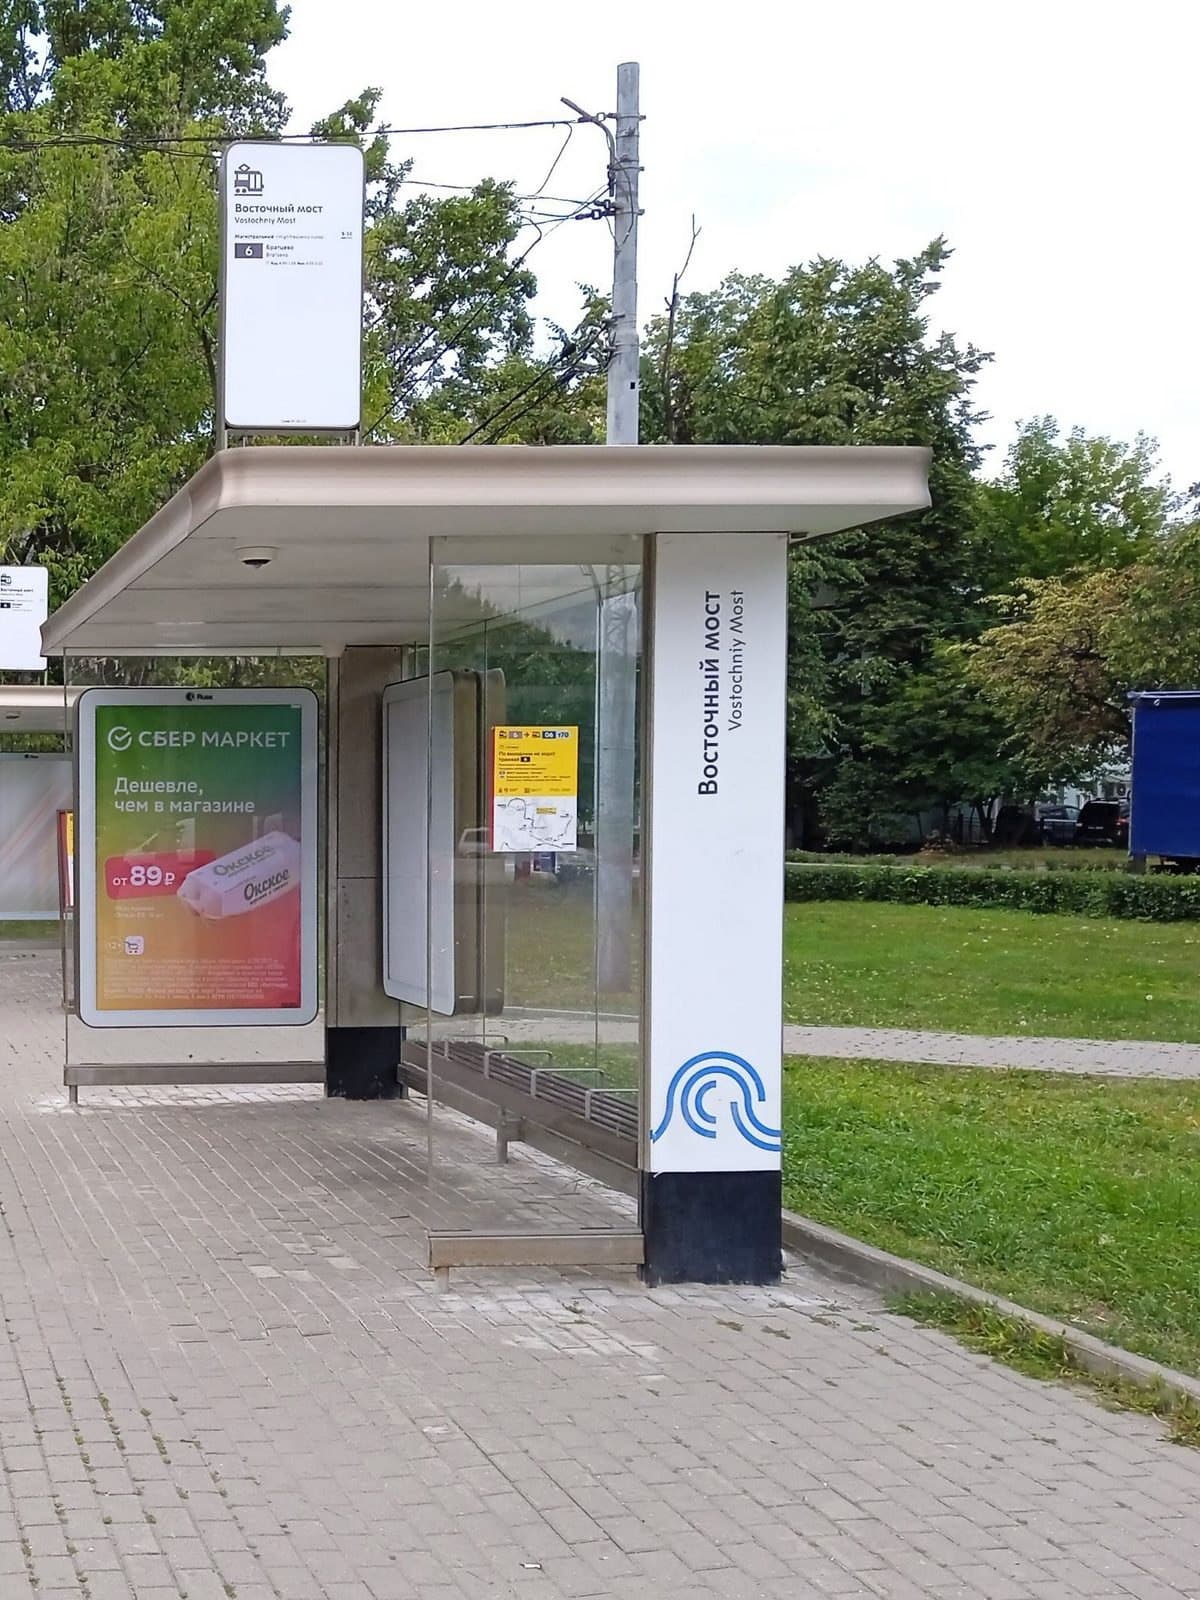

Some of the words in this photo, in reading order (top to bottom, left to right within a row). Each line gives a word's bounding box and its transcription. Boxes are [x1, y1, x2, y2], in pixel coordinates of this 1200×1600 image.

[235, 203, 295, 213] Восточный
[297, 205, 323, 213] мост
[234, 216, 275, 225] Vostochniy
[276, 216, 296, 224] Most
[245, 245, 253, 257] 6
[705, 590, 721, 651] мост
[729, 589, 744, 634] Most
[728, 638, 747, 731] Vostochniy
[698, 658, 720, 795] Восточный
[138, 731, 196, 748] СБЕР
[202, 731, 291, 748] МАРКЕТ
[114, 777, 203, 796] Дешевле,
[114, 801, 149, 813] чем
[154, 802, 164, 812] в
[169, 800, 255, 814] магазине
[112, 877, 128, 886] от
[130, 865, 163, 887] 89
[244, 869, 289, 901] Окское
